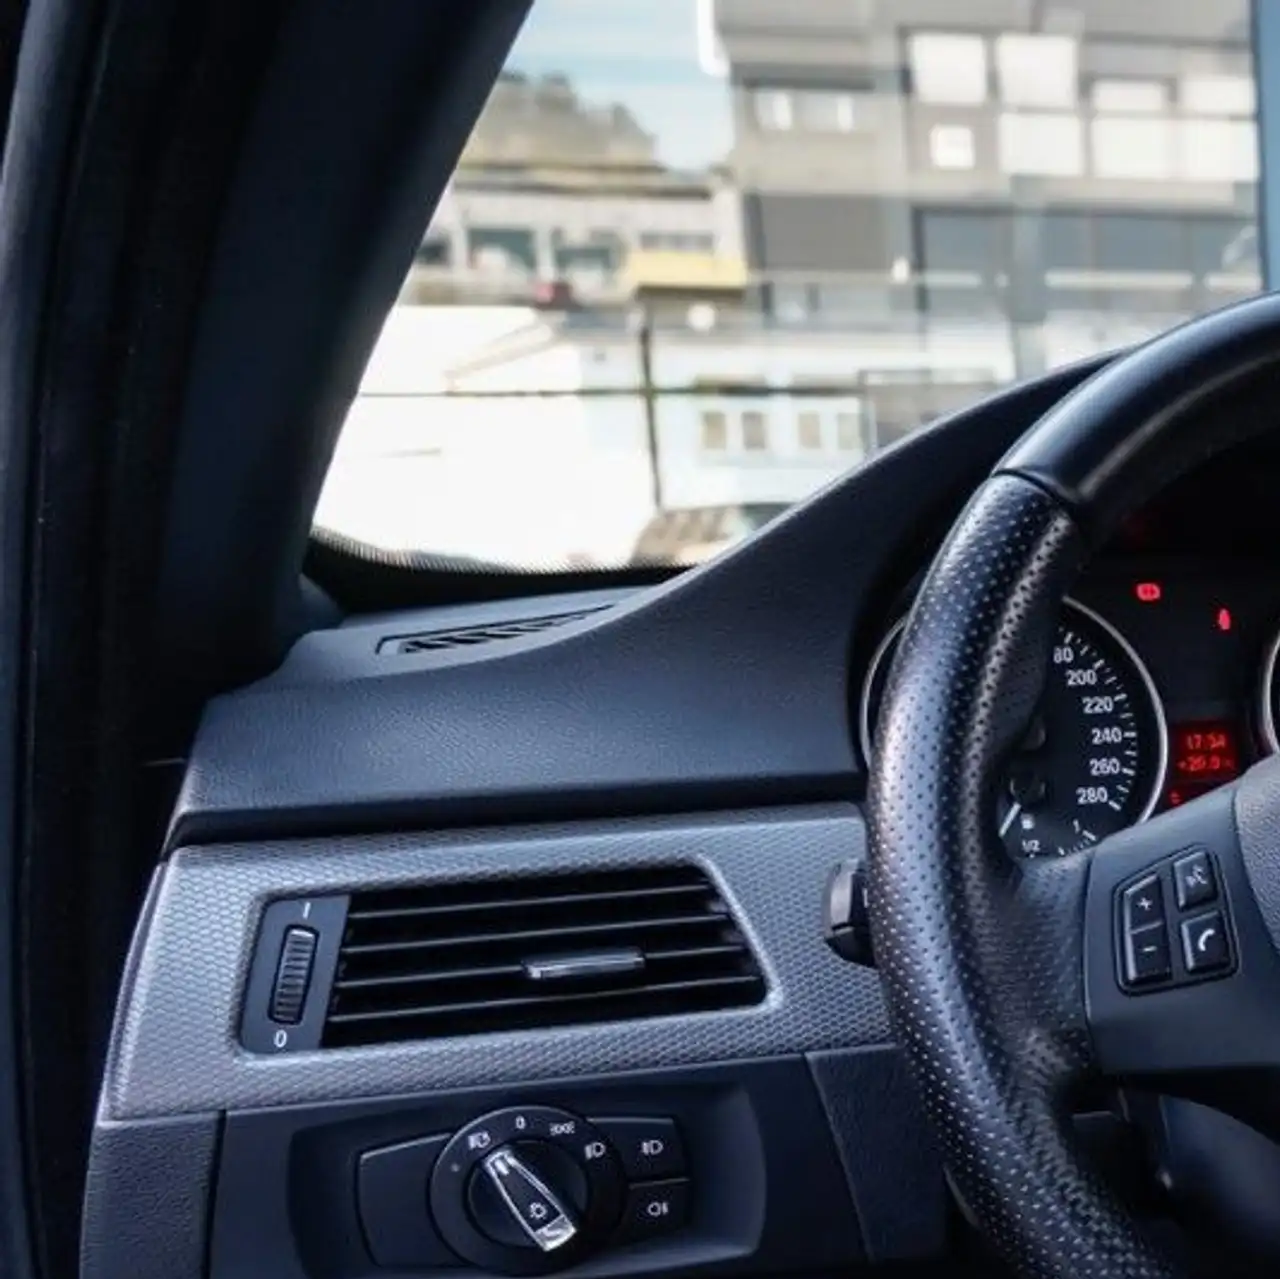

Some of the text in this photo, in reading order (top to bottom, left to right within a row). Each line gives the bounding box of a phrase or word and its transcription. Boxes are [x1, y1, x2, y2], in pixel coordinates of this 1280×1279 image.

[1066, 668, 1098, 686] 200
[1082, 696, 1114, 714] 220
[1091, 726, 1122, 745] 240
[1089, 758, 1121, 776] 260
[1076, 786, 1108, 805] 280
